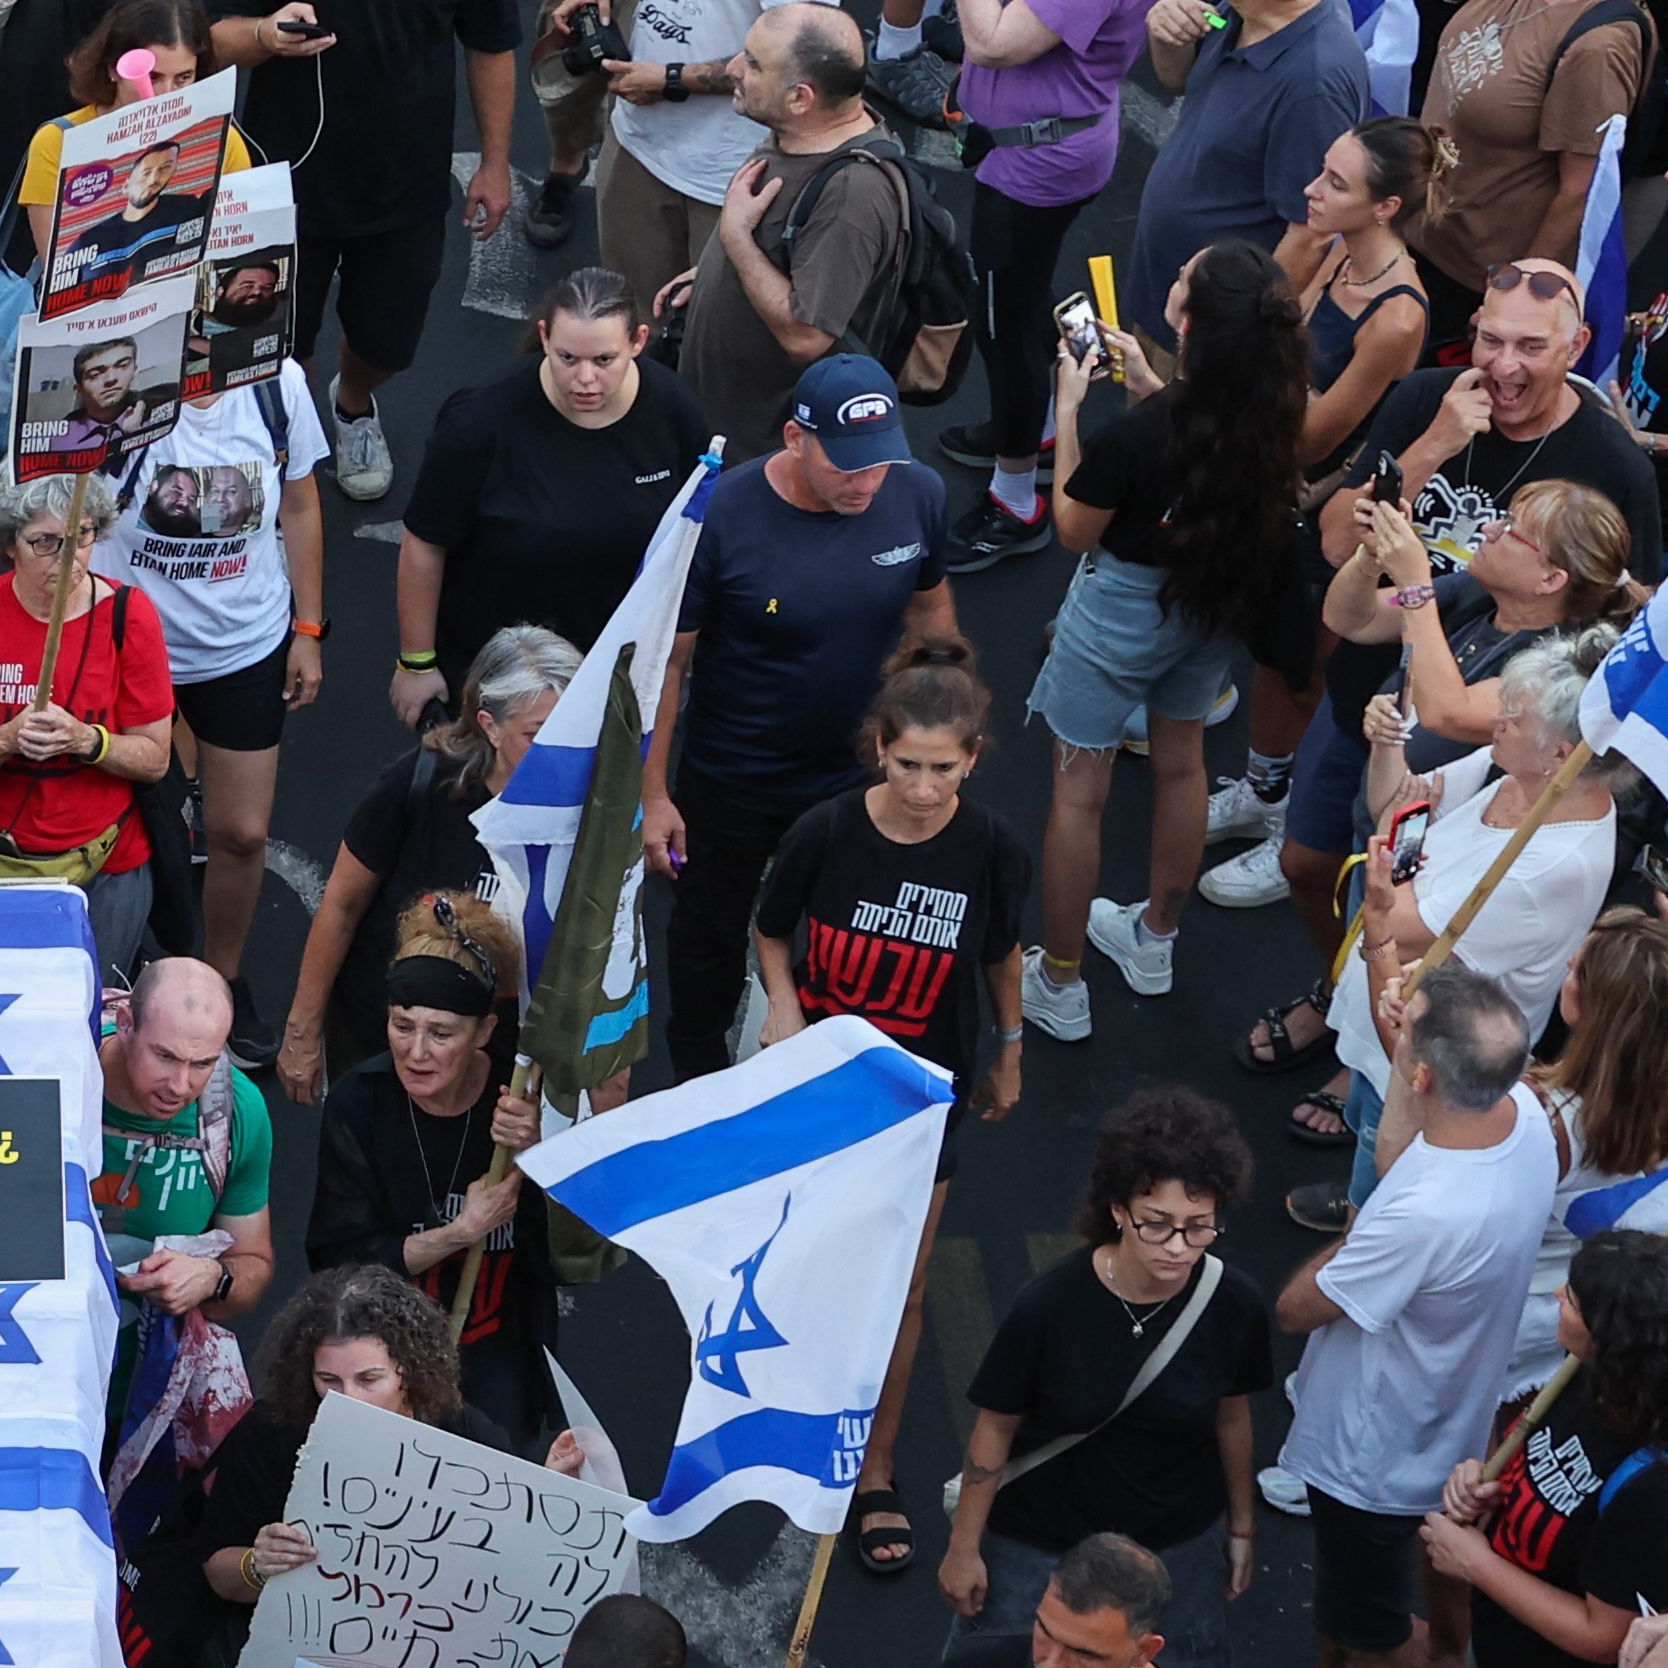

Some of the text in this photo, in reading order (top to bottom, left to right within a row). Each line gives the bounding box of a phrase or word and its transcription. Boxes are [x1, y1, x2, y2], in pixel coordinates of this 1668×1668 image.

[107, 119, 144, 144] HAMZAH
[139, 130, 158, 146] (22)
[224, 201, 248, 216] HORN
[231, 233, 254, 247] HORN
[53, 244, 99, 275] BRING
[49, 267, 80, 293] HIM
[183, 371, 212, 394] OW!
[21, 419, 69, 438] BRING
[20, 437, 51, 454] HIM
[143, 538, 247, 558] BRING IAIR AND
[130, 549, 248, 580] EITAN HOME NOW!
[17, 684, 54, 705] HOE
[896, 881, 968, 921] מחזירים
[851, 900, 962, 949] אותם הביתה
[808, 917, 954, 1019] עכשיו
[395, 1438, 627, 1559] תסתכלו
[118, 1561, 142, 1593] OME
[451, 1575, 575, 1636] כולנו
